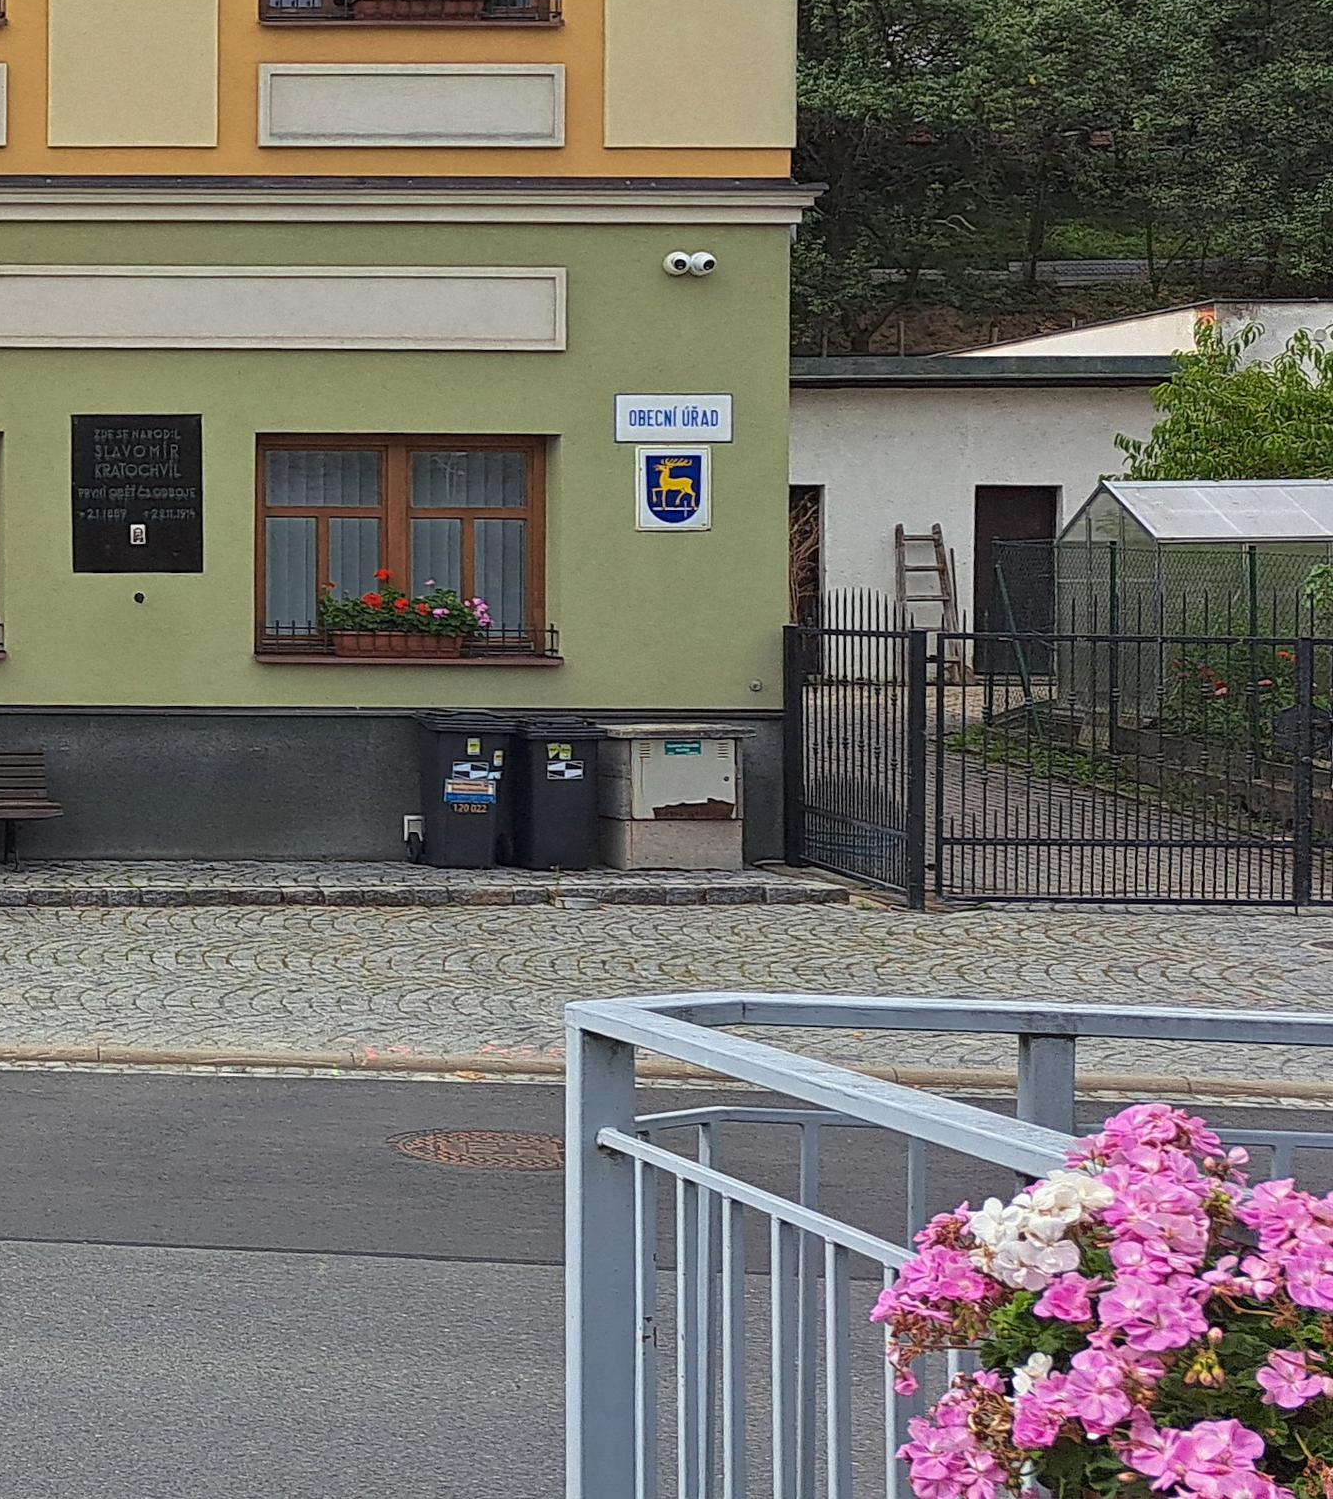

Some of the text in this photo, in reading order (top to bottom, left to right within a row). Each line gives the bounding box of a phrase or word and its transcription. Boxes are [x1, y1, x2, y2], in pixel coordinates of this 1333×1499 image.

[629, 406, 719, 427] OBECNÍ ÚŘAD
[94, 442, 180, 458] SLAVOMÍR
[94, 460, 182, 478] KRATOCHVÍL
